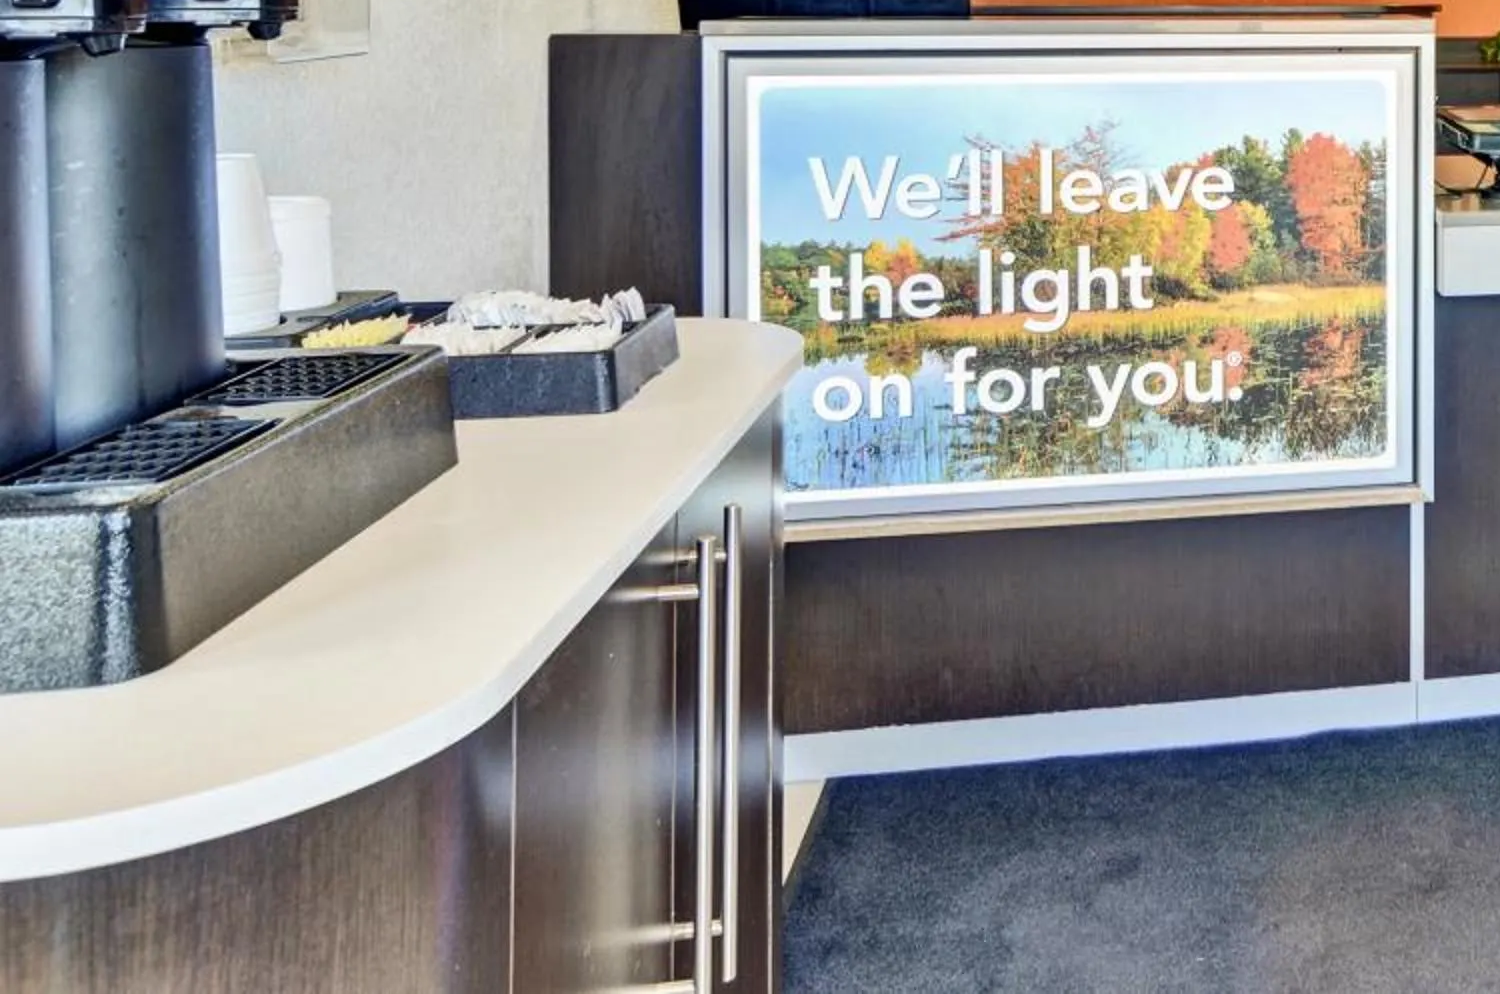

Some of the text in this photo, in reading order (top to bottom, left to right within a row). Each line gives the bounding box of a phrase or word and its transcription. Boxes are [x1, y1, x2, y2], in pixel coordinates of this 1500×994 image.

[1039, 149, 1235, 215] leave
[809, 244, 1155, 333] the light
[812, 368, 914, 423] on
[945, 346, 1062, 416] for
